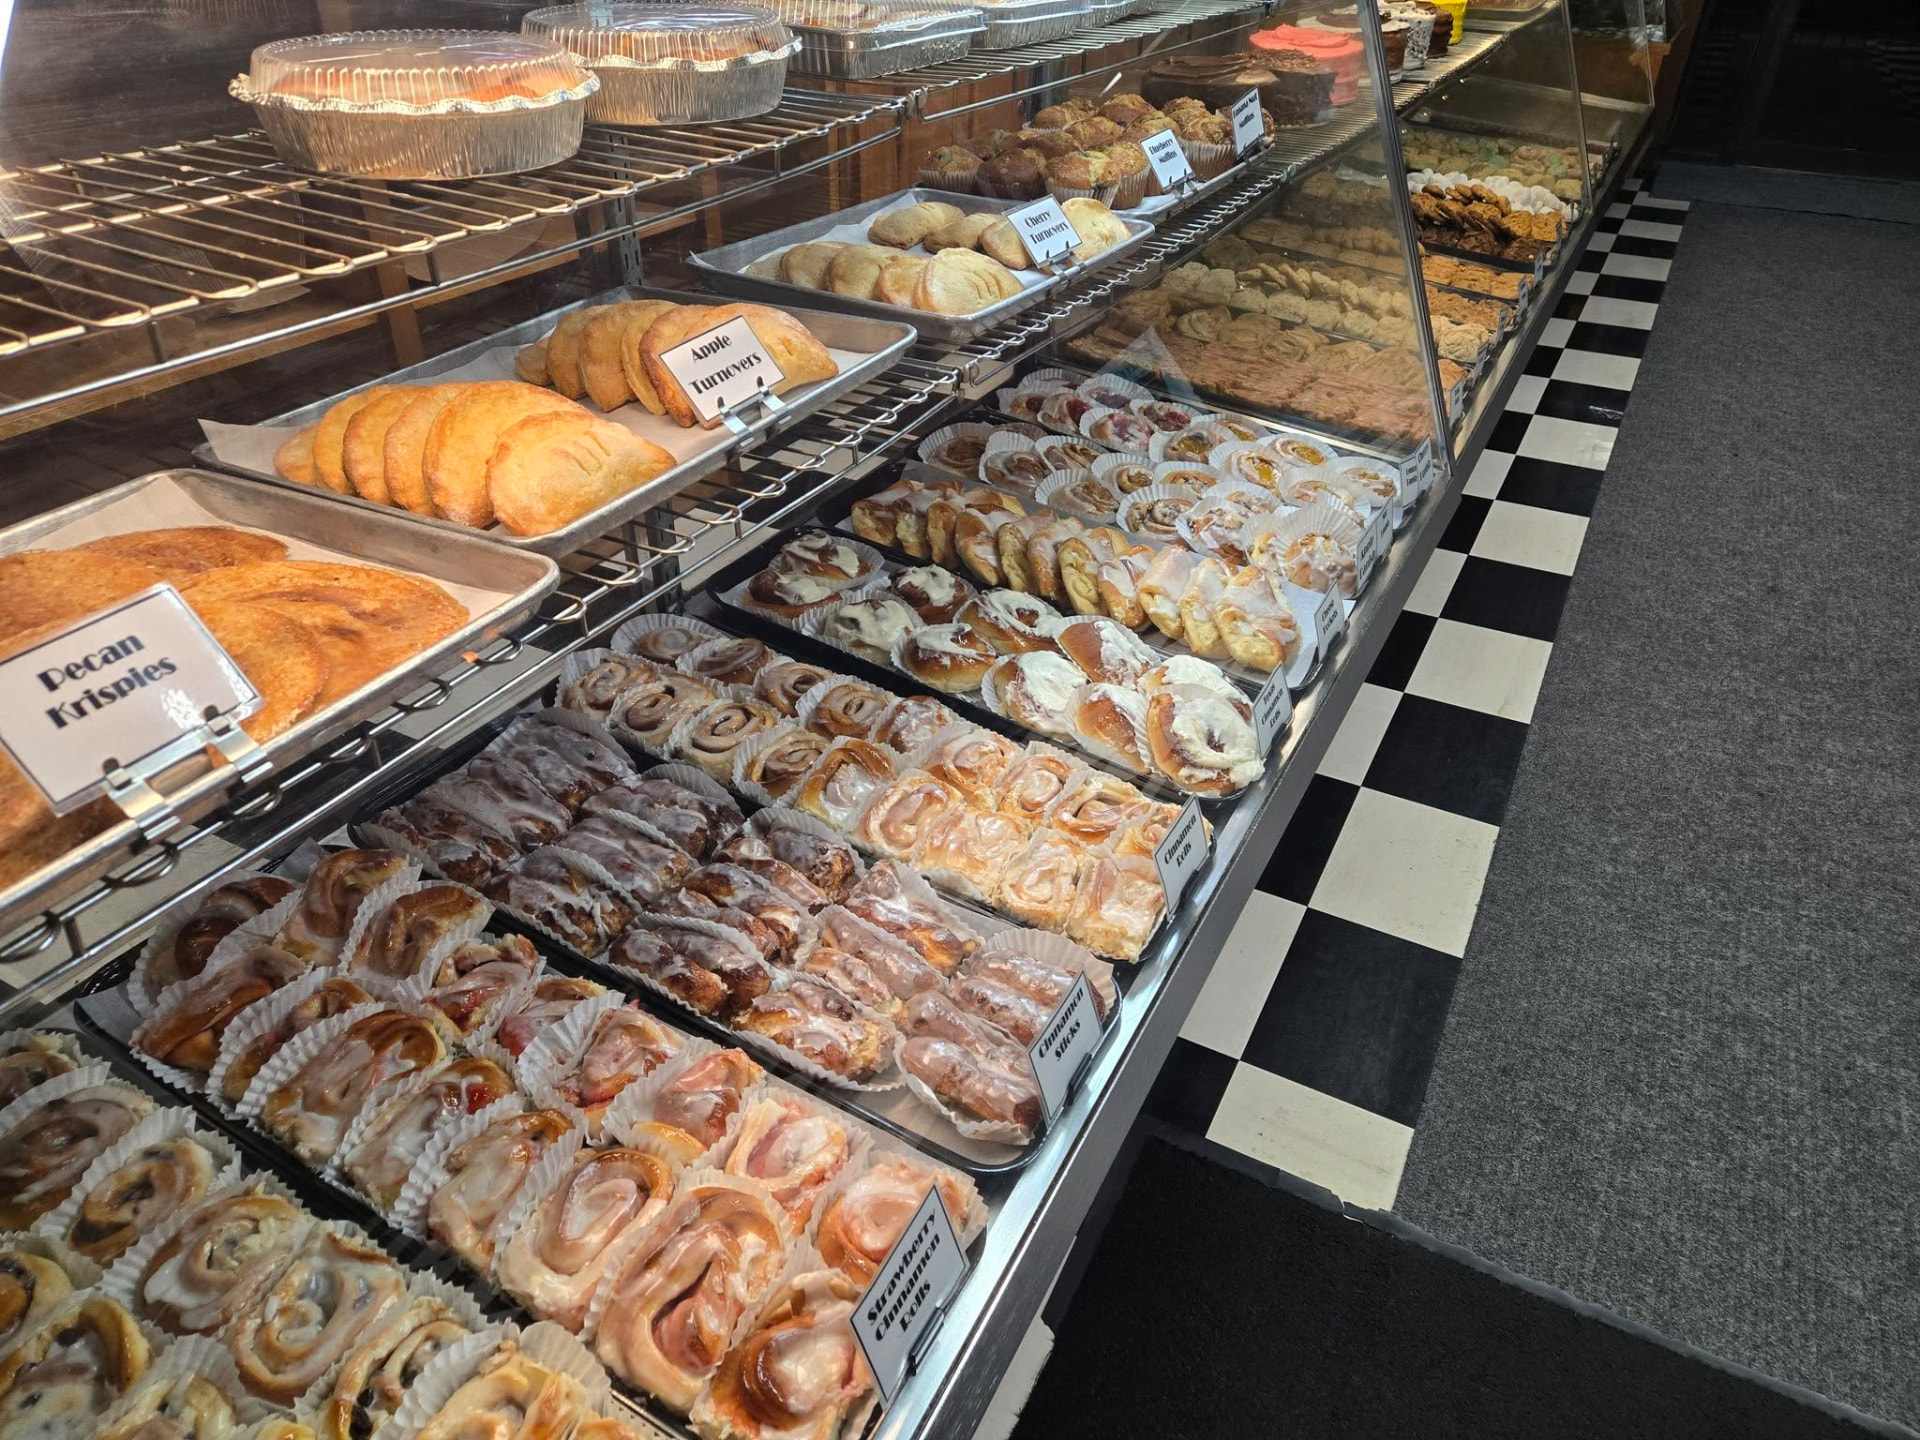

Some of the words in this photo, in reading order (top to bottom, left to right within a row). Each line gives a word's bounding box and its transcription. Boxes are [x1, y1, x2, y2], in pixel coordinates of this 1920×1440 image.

[1024, 211, 1051, 228] Cherry
[1029, 221, 1069, 244] Turnovers
[691, 334, 733, 363] Apple
[688, 352, 762, 394] Turnovers
[36, 634, 146, 693] Pecan
[45, 656, 178, 730] Krispies
[1261, 687, 1284, 726] Cinnamon
[1163, 813, 1197, 865] Cinnamon
[1176, 840, 1192, 868] Rolls
[1038, 987, 1084, 1059] Cinnamon
[1054, 1018, 1081, 1062] Sticks
[866, 1208, 936, 1326] Strawberry
[874, 1232, 941, 1342] Cinnamon
[899, 1279, 931, 1333] Rolls
